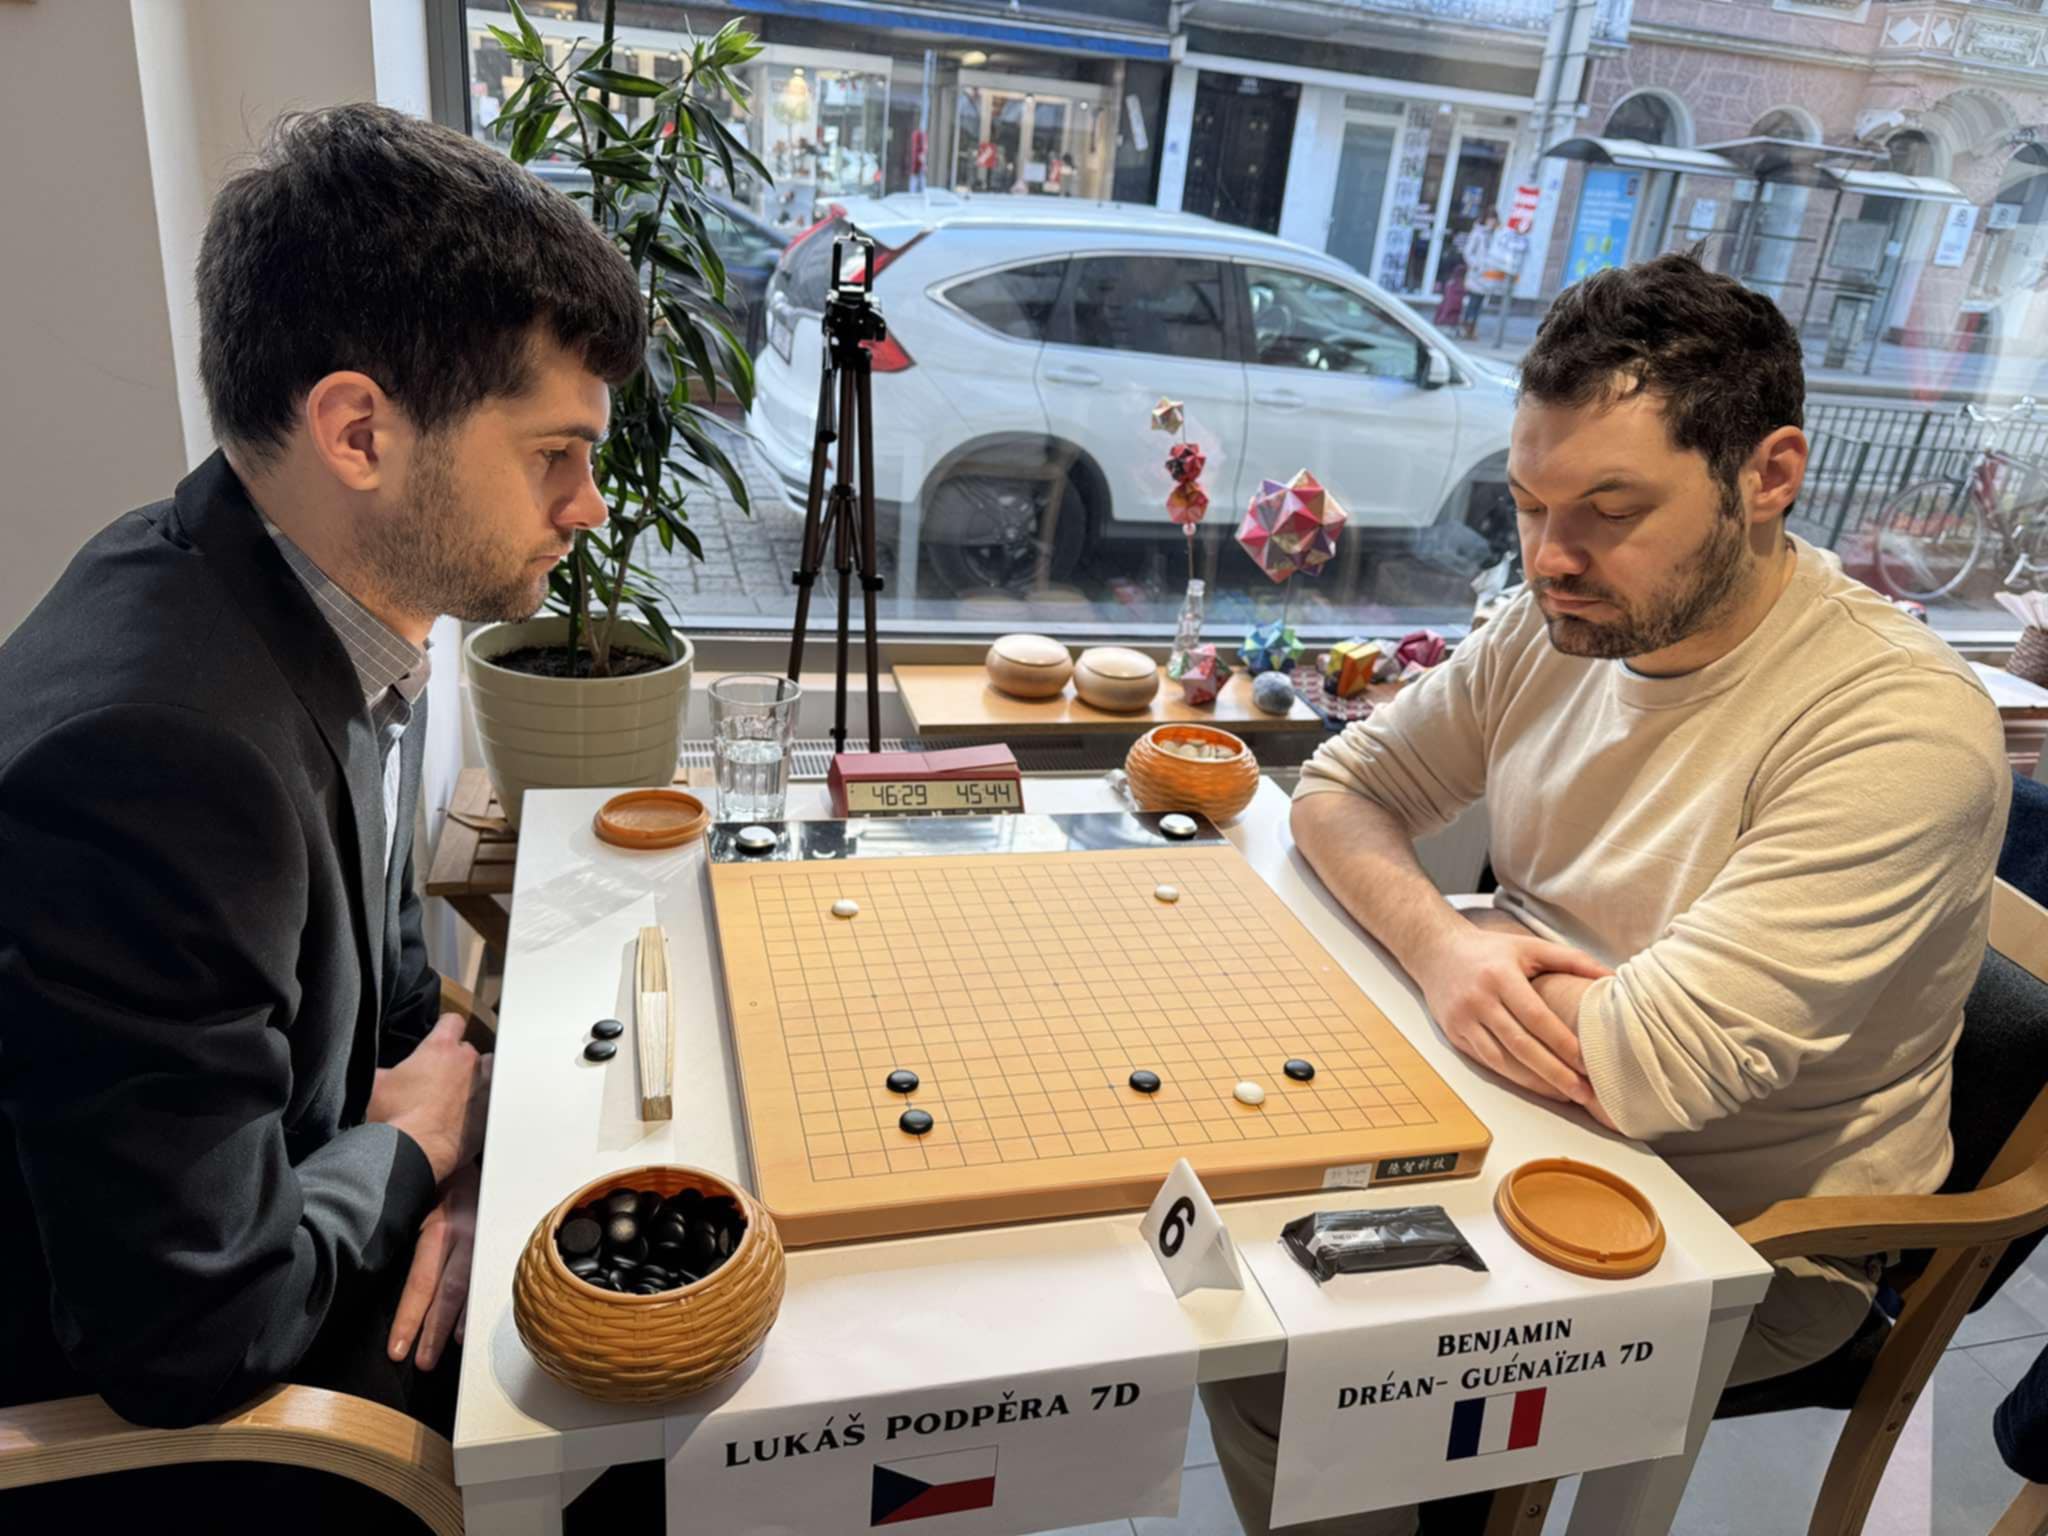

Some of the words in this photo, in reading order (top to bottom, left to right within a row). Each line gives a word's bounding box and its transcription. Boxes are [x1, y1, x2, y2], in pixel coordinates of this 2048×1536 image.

[1158, 1196, 1196, 1258] 6
[1438, 1319, 1571, 1357] BENJAMIN
[1461, 1350, 1606, 1389] GUÉNAÏZIA
[1620, 1341, 1653, 1364] 7D
[726, 1412, 865, 1468] LUKÁŠ
[885, 1390, 1070, 1440] PODPĚRA
[1091, 1382, 1140, 1410] 7D
